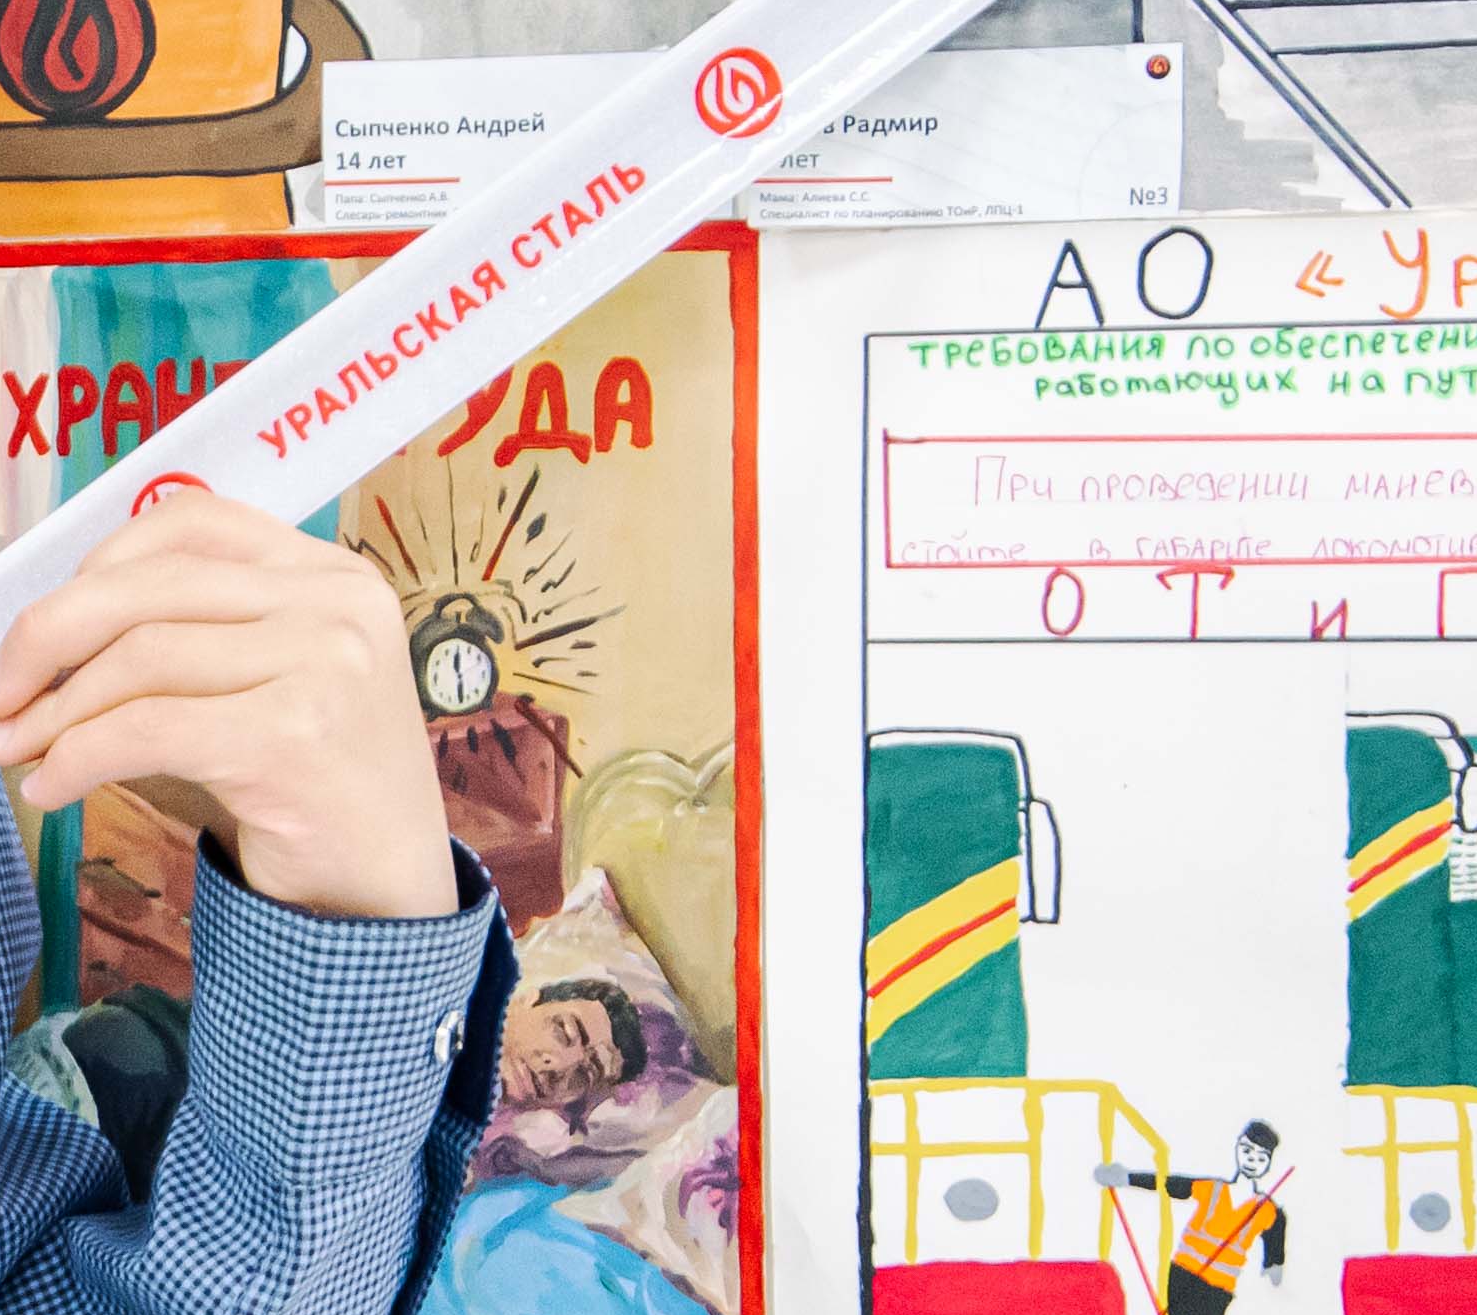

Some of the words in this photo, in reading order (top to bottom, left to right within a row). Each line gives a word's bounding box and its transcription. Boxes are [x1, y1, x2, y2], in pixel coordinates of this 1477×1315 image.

[335, 119, 449, 138] Сыпченко
[457, 112, 545, 138] Андрей
[843, 115, 939, 137] Радмир
[336, 152, 361, 171] 14
[369, 154, 407, 170] лет
[1129, 187, 1169, 207] №3
[255, 258, 507, 461] УРАЛЬСКАЯ
[510, 156, 651, 271] СТАЛЬ
